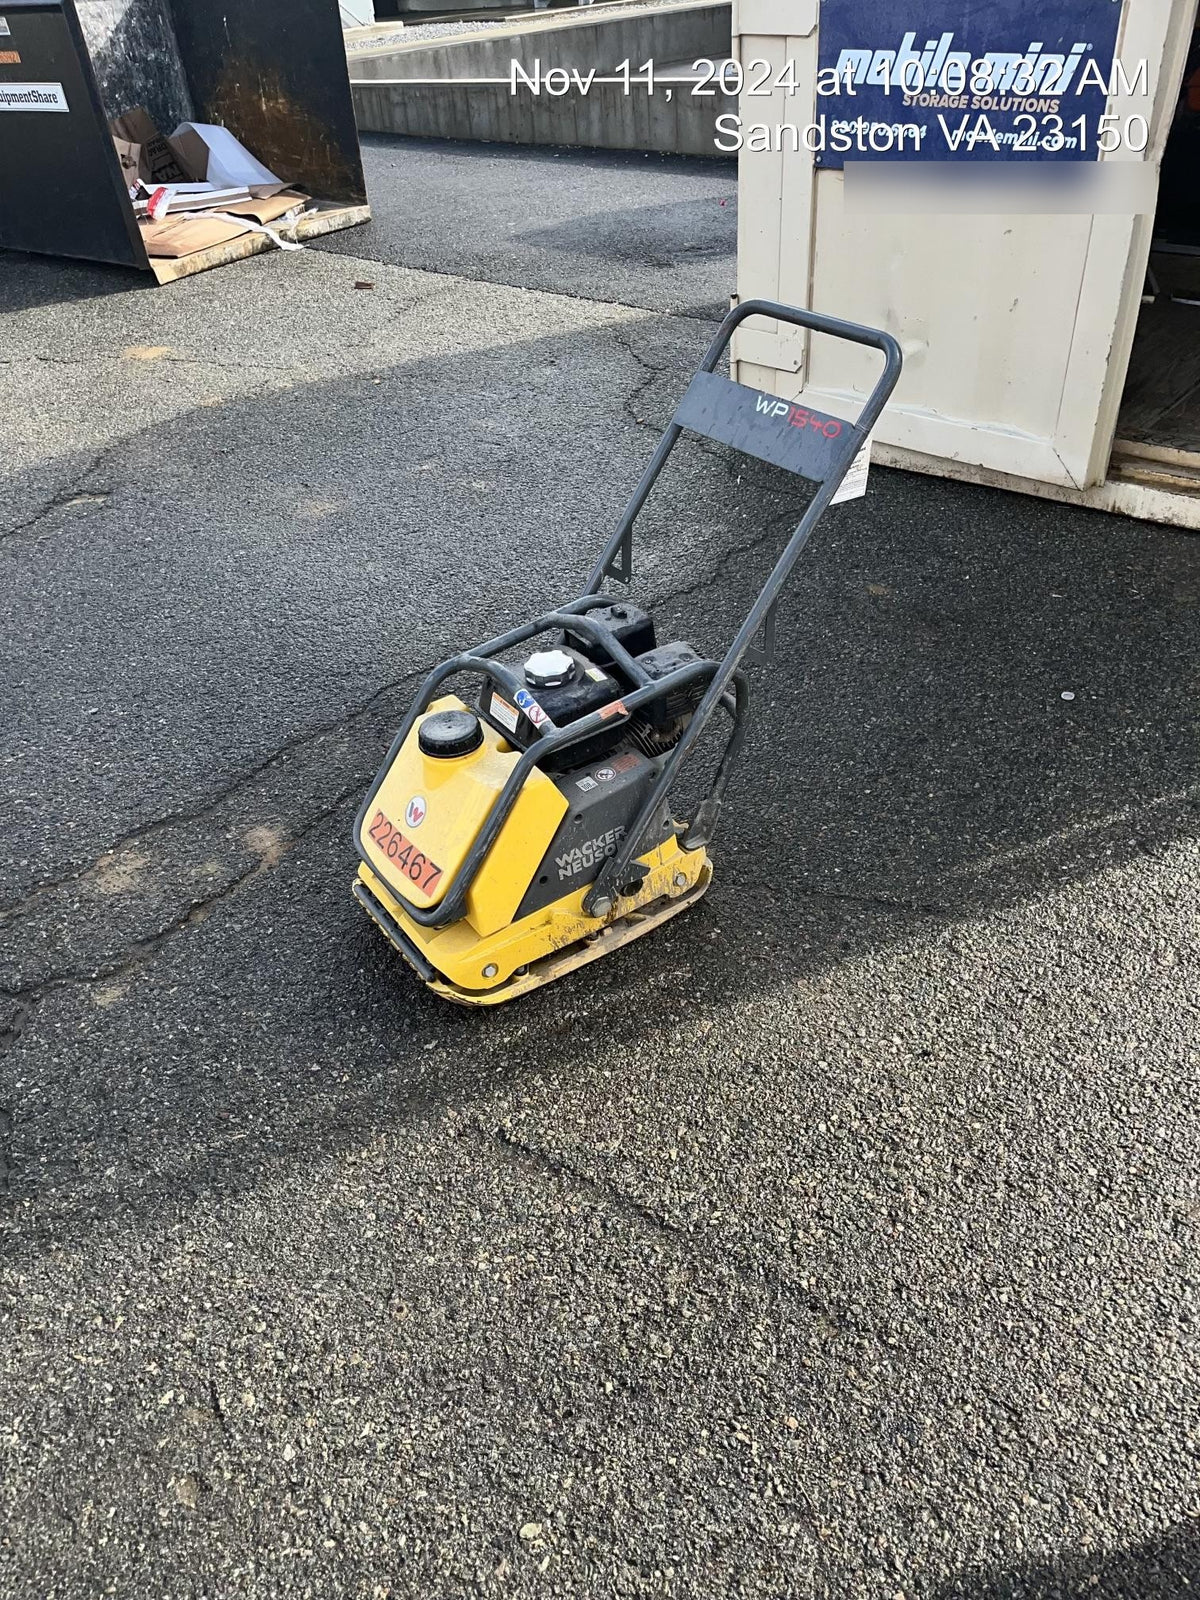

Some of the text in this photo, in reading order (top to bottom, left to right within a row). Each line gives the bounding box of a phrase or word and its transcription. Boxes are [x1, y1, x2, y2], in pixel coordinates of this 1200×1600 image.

[833, 32, 972, 88] mobile
[902, 94, 1061, 113] STORAGE SOLUTIONS
[755, 395, 842, 439] WP1540
[368, 812, 442, 889] 226467
[555, 825, 627, 868] WACKER
[558, 843, 618, 881] NEUSO
